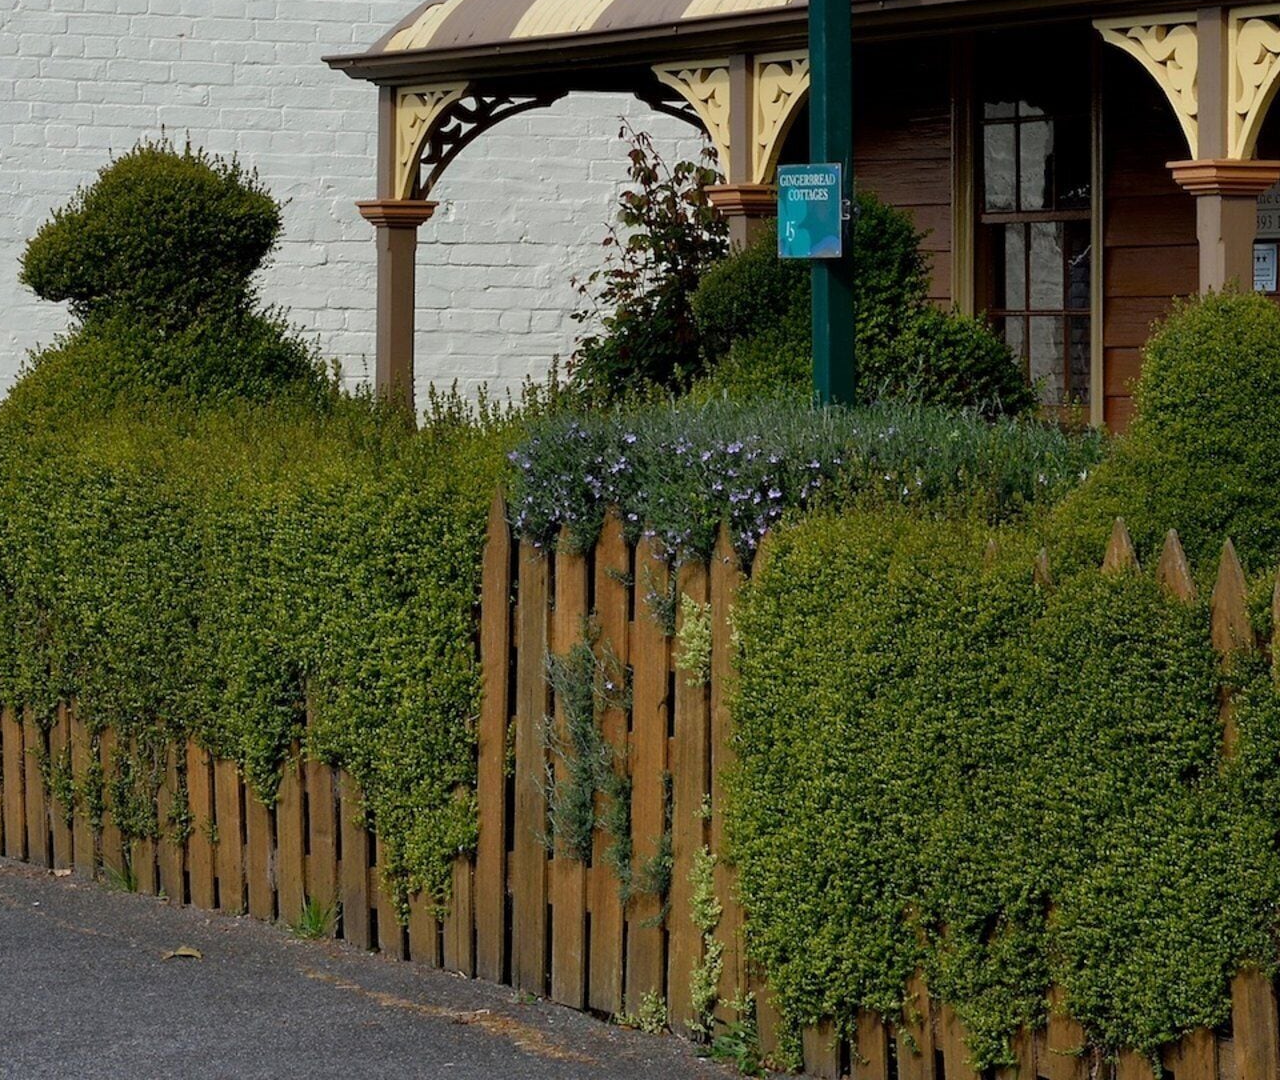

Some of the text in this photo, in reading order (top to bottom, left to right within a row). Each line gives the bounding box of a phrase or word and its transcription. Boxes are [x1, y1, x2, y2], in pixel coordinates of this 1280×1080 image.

[779, 173, 836, 187] GINGERBREAD
[788, 188, 829, 201] COTTAGES
[785, 221, 796, 242] 15
